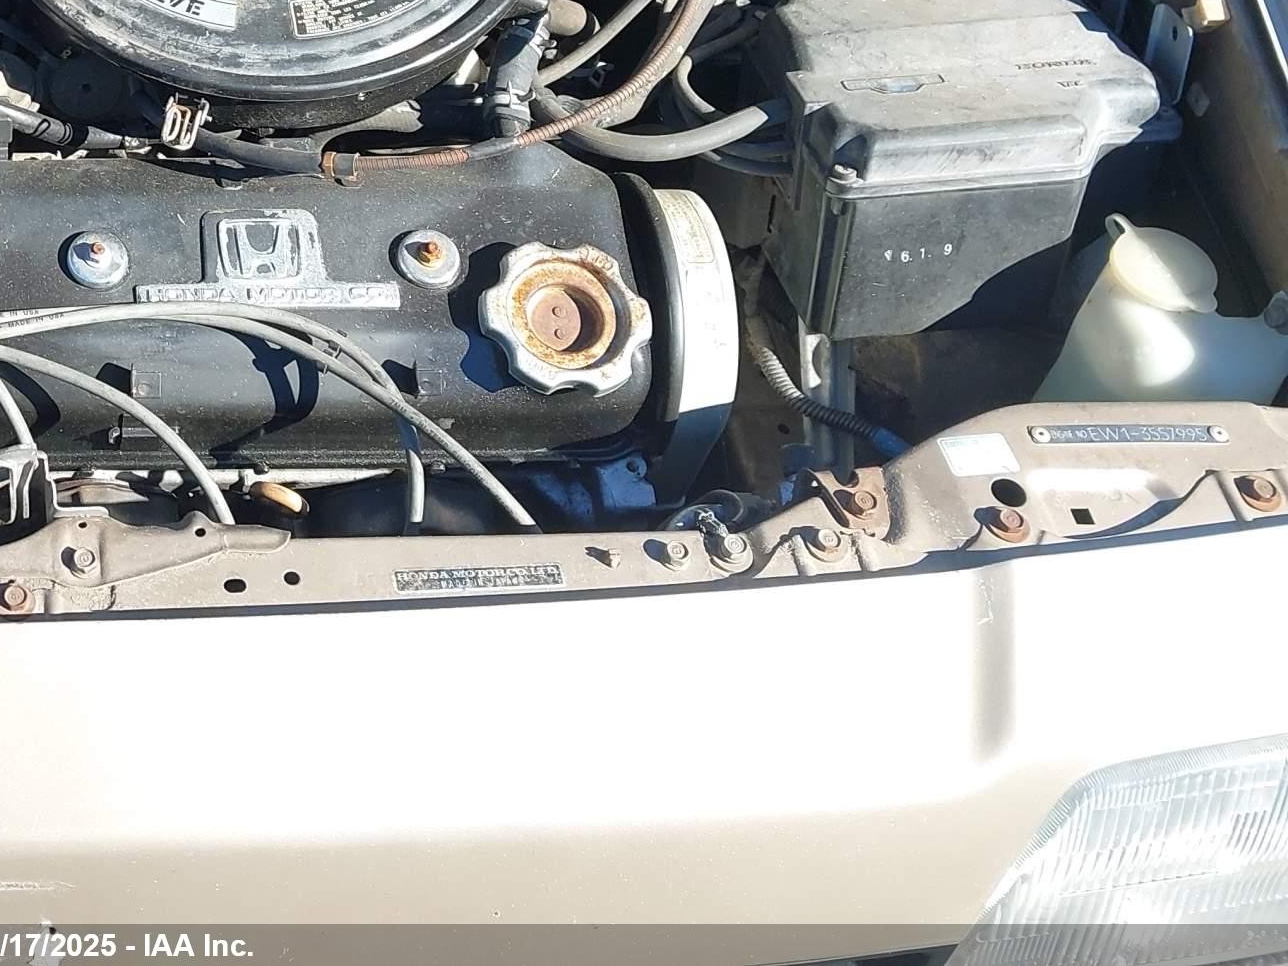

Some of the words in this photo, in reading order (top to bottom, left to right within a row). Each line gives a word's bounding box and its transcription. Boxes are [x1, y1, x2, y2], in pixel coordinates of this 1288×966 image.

[1087, 425, 1208, 442] EW1-3557995
[396, 570, 449, 582] HONDA
[450, 568, 507, 579] MOTOR
